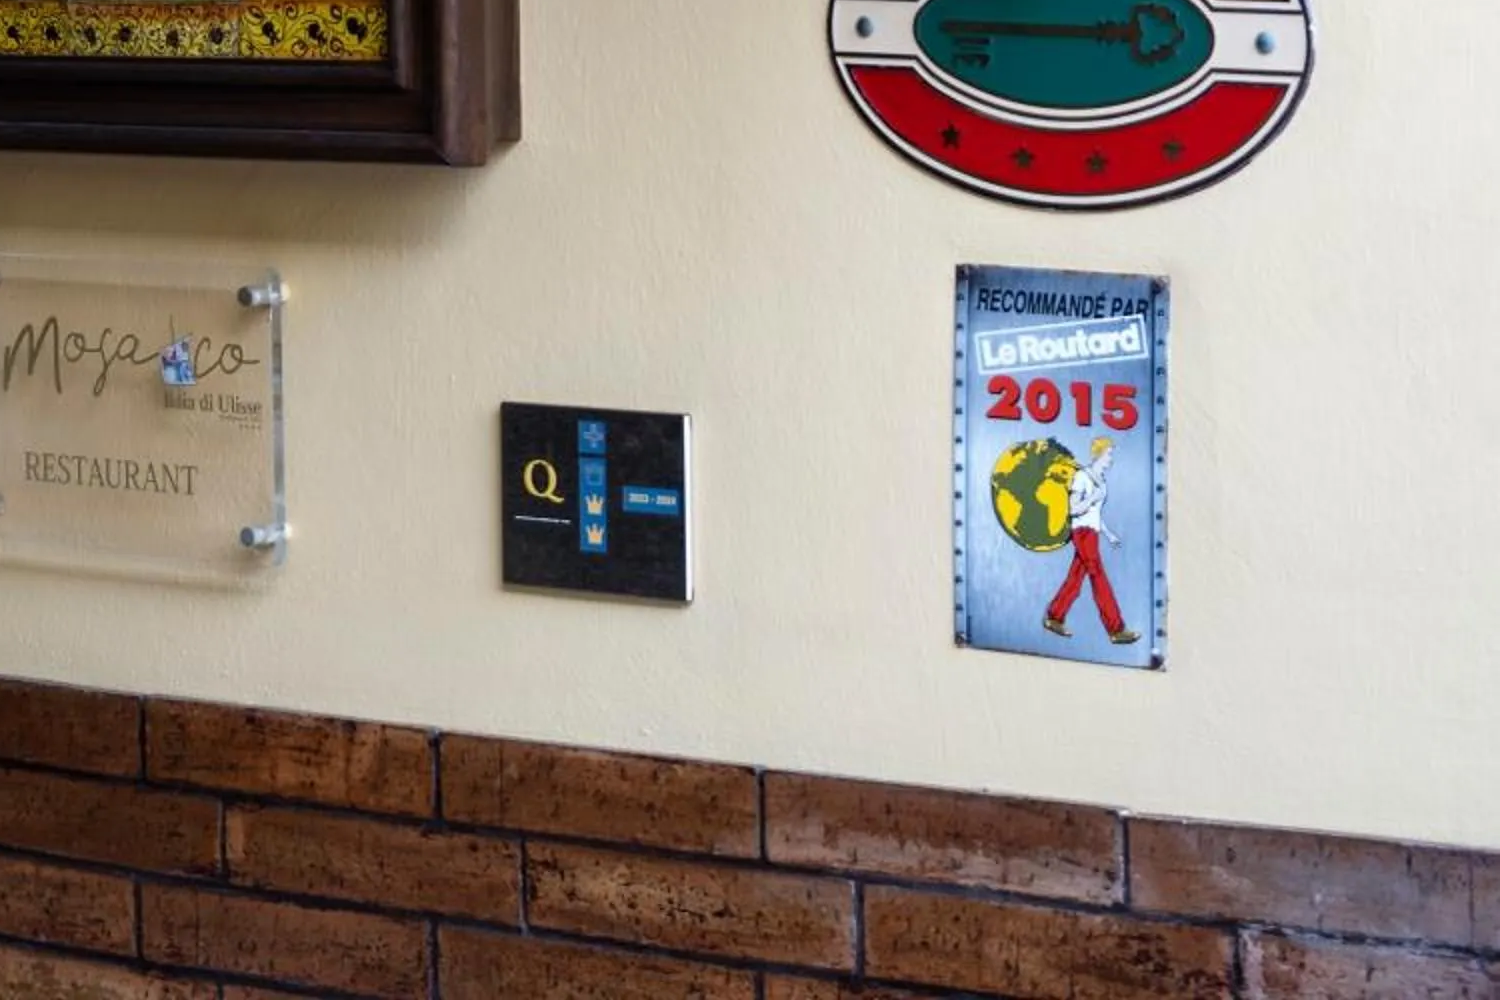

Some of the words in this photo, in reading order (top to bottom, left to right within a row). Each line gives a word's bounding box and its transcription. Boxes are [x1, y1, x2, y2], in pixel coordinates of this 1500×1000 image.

[976, 287, 1105, 319] RECOMMANDÉ
[1109, 298, 1149, 322] PAR
[986, 374, 1140, 431] 2015
[24, 451, 199, 497] RESTAURANT
[523, 458, 565, 504] Q
